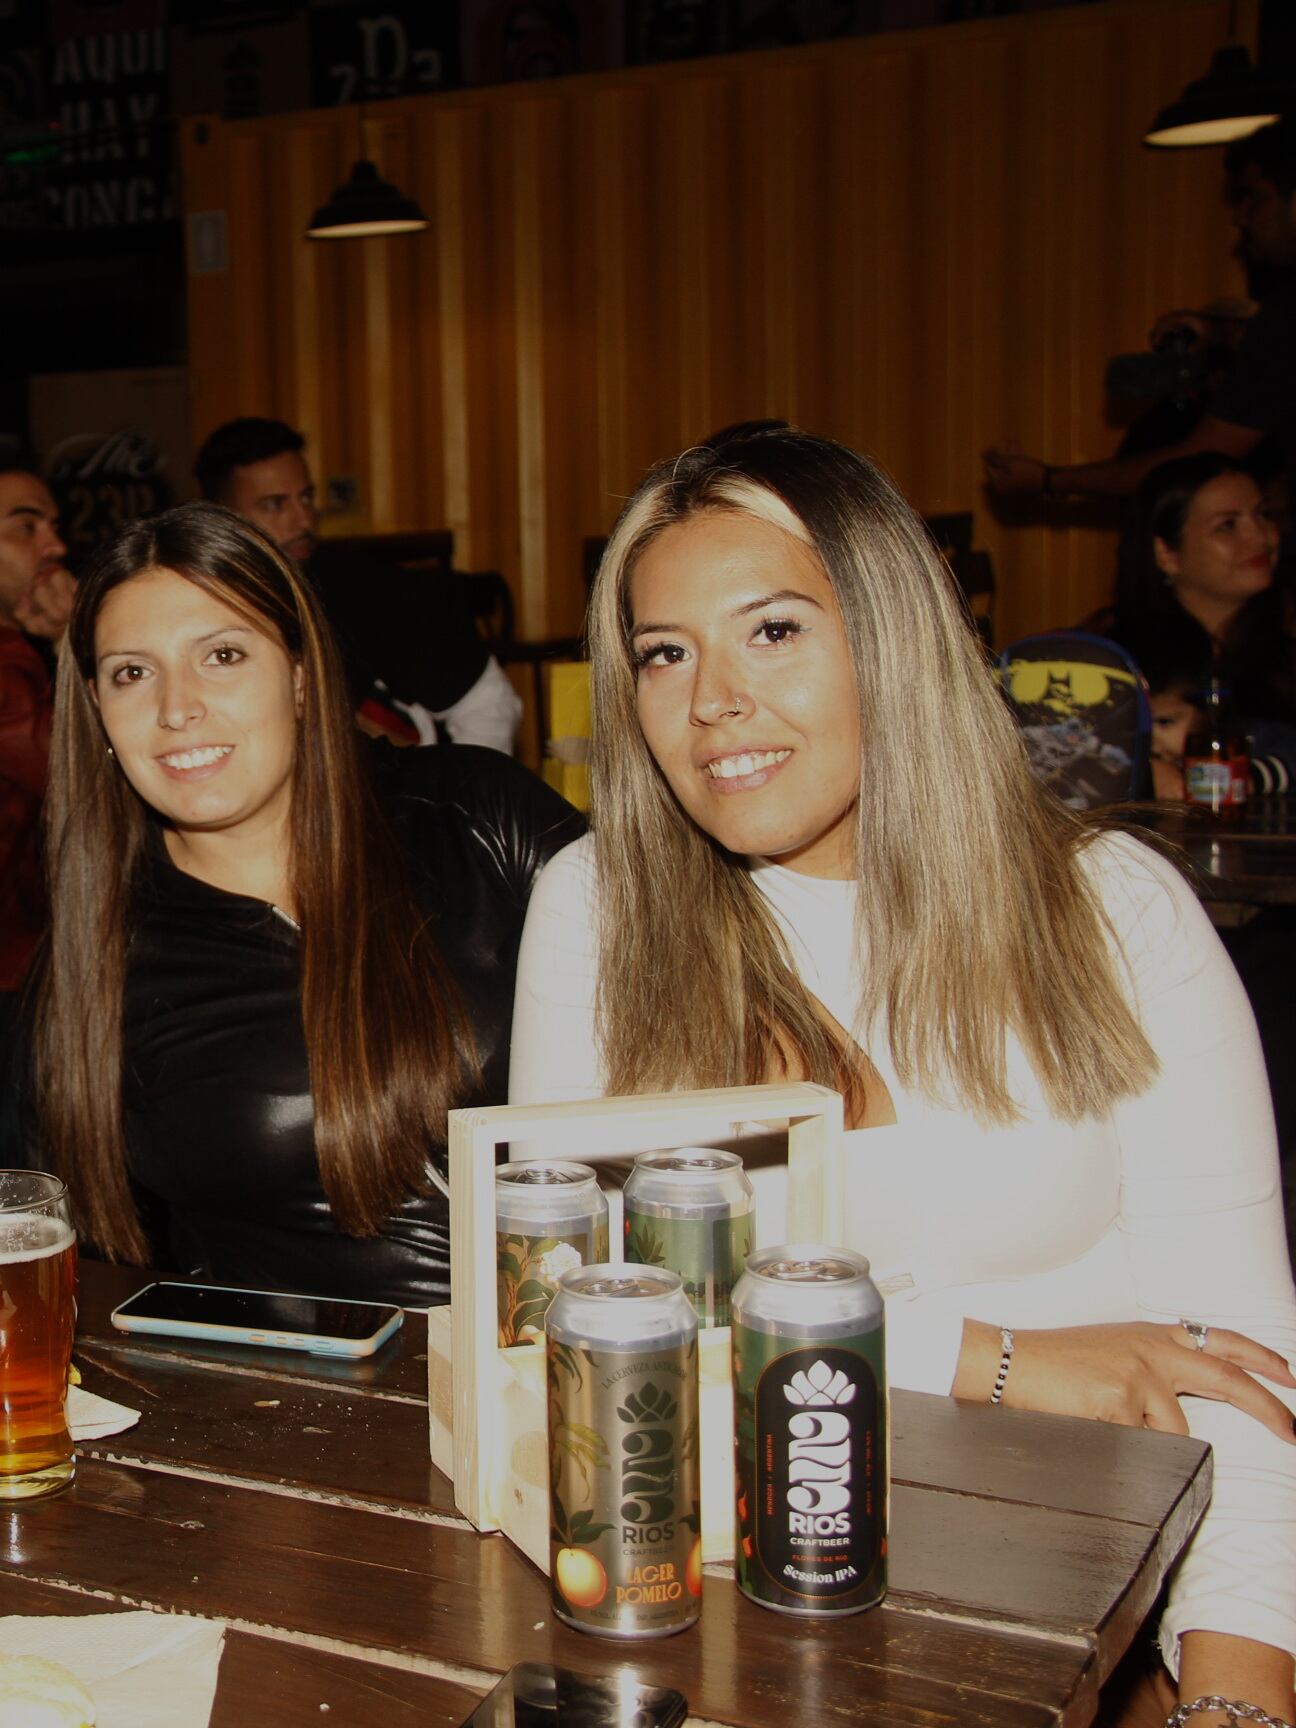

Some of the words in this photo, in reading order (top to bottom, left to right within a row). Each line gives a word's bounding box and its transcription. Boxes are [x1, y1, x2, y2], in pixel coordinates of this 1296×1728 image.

[61, 95, 160, 163] HAY
[622, 1521, 675, 1545] RIOS
[789, 1511, 852, 1536] RIOS
[789, 1536, 851, 1547] CRAFTBEER
[626, 1562, 675, 1585] LAGER
[782, 1564, 834, 1584] Session
[834, 1564, 858, 1583] IPA
[616, 1581, 683, 1605] POMELO
